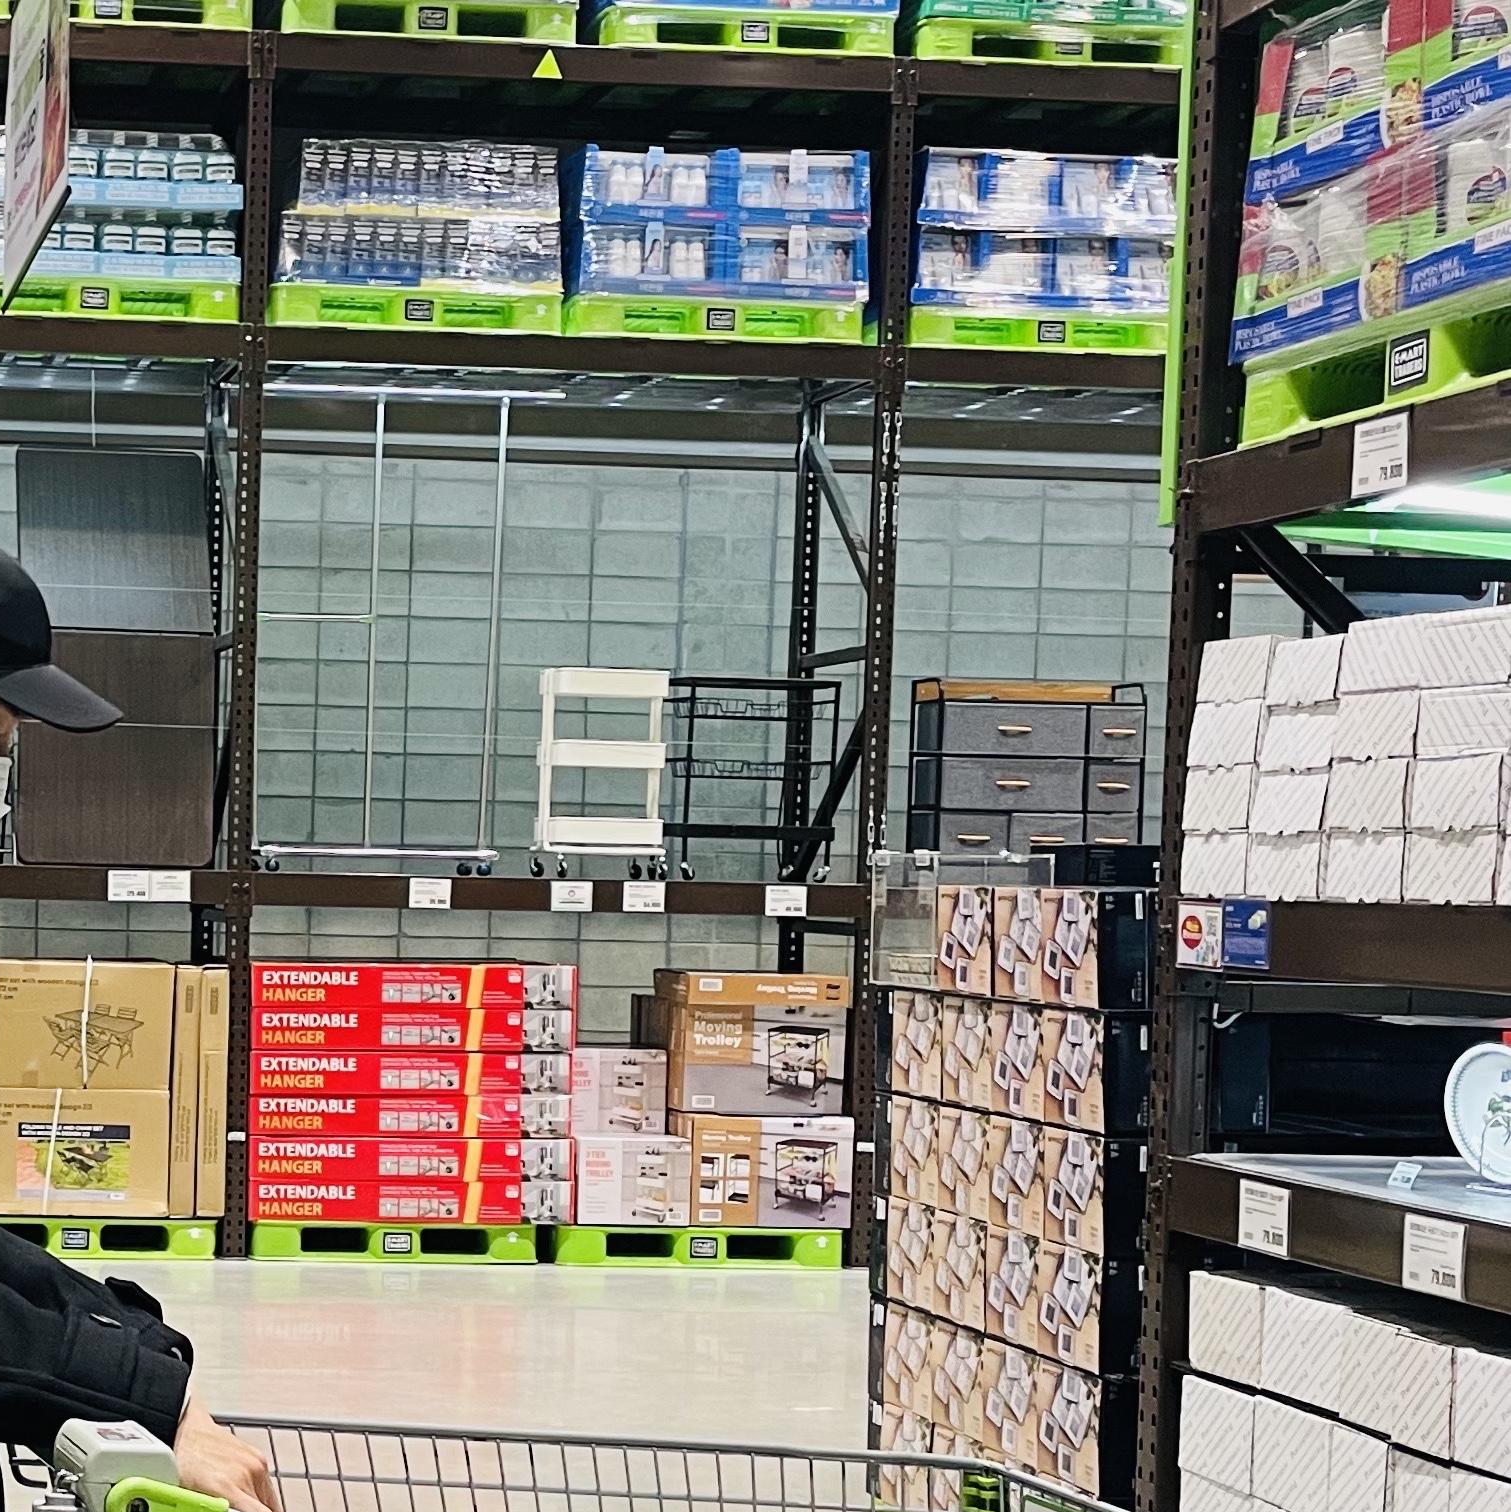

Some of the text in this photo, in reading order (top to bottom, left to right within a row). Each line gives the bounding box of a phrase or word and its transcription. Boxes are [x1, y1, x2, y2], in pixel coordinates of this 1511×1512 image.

[261, 970, 359, 986] EXTENDABLE
[261, 988, 326, 1002] HANGER
[261, 1013, 358, 1028] EXTENDABLE
[693, 1020, 743, 1036] Moving
[261, 1031, 325, 1045] HANGER
[693, 1033, 742, 1048] Trolley
[260, 1057, 357, 1072] EXTENDABLE
[260, 1074, 324, 1089] HANGER
[258, 1099, 356, 1114] EXTENDABLE
[258, 1116, 322, 1130] HANGER
[258, 1142, 356, 1158] EXTENDABLE
[258, 1160, 322, 1174] HANGER
[258, 1185, 356, 1200] EXTENDABLE
[258, 1202, 322, 1216] HANGER
